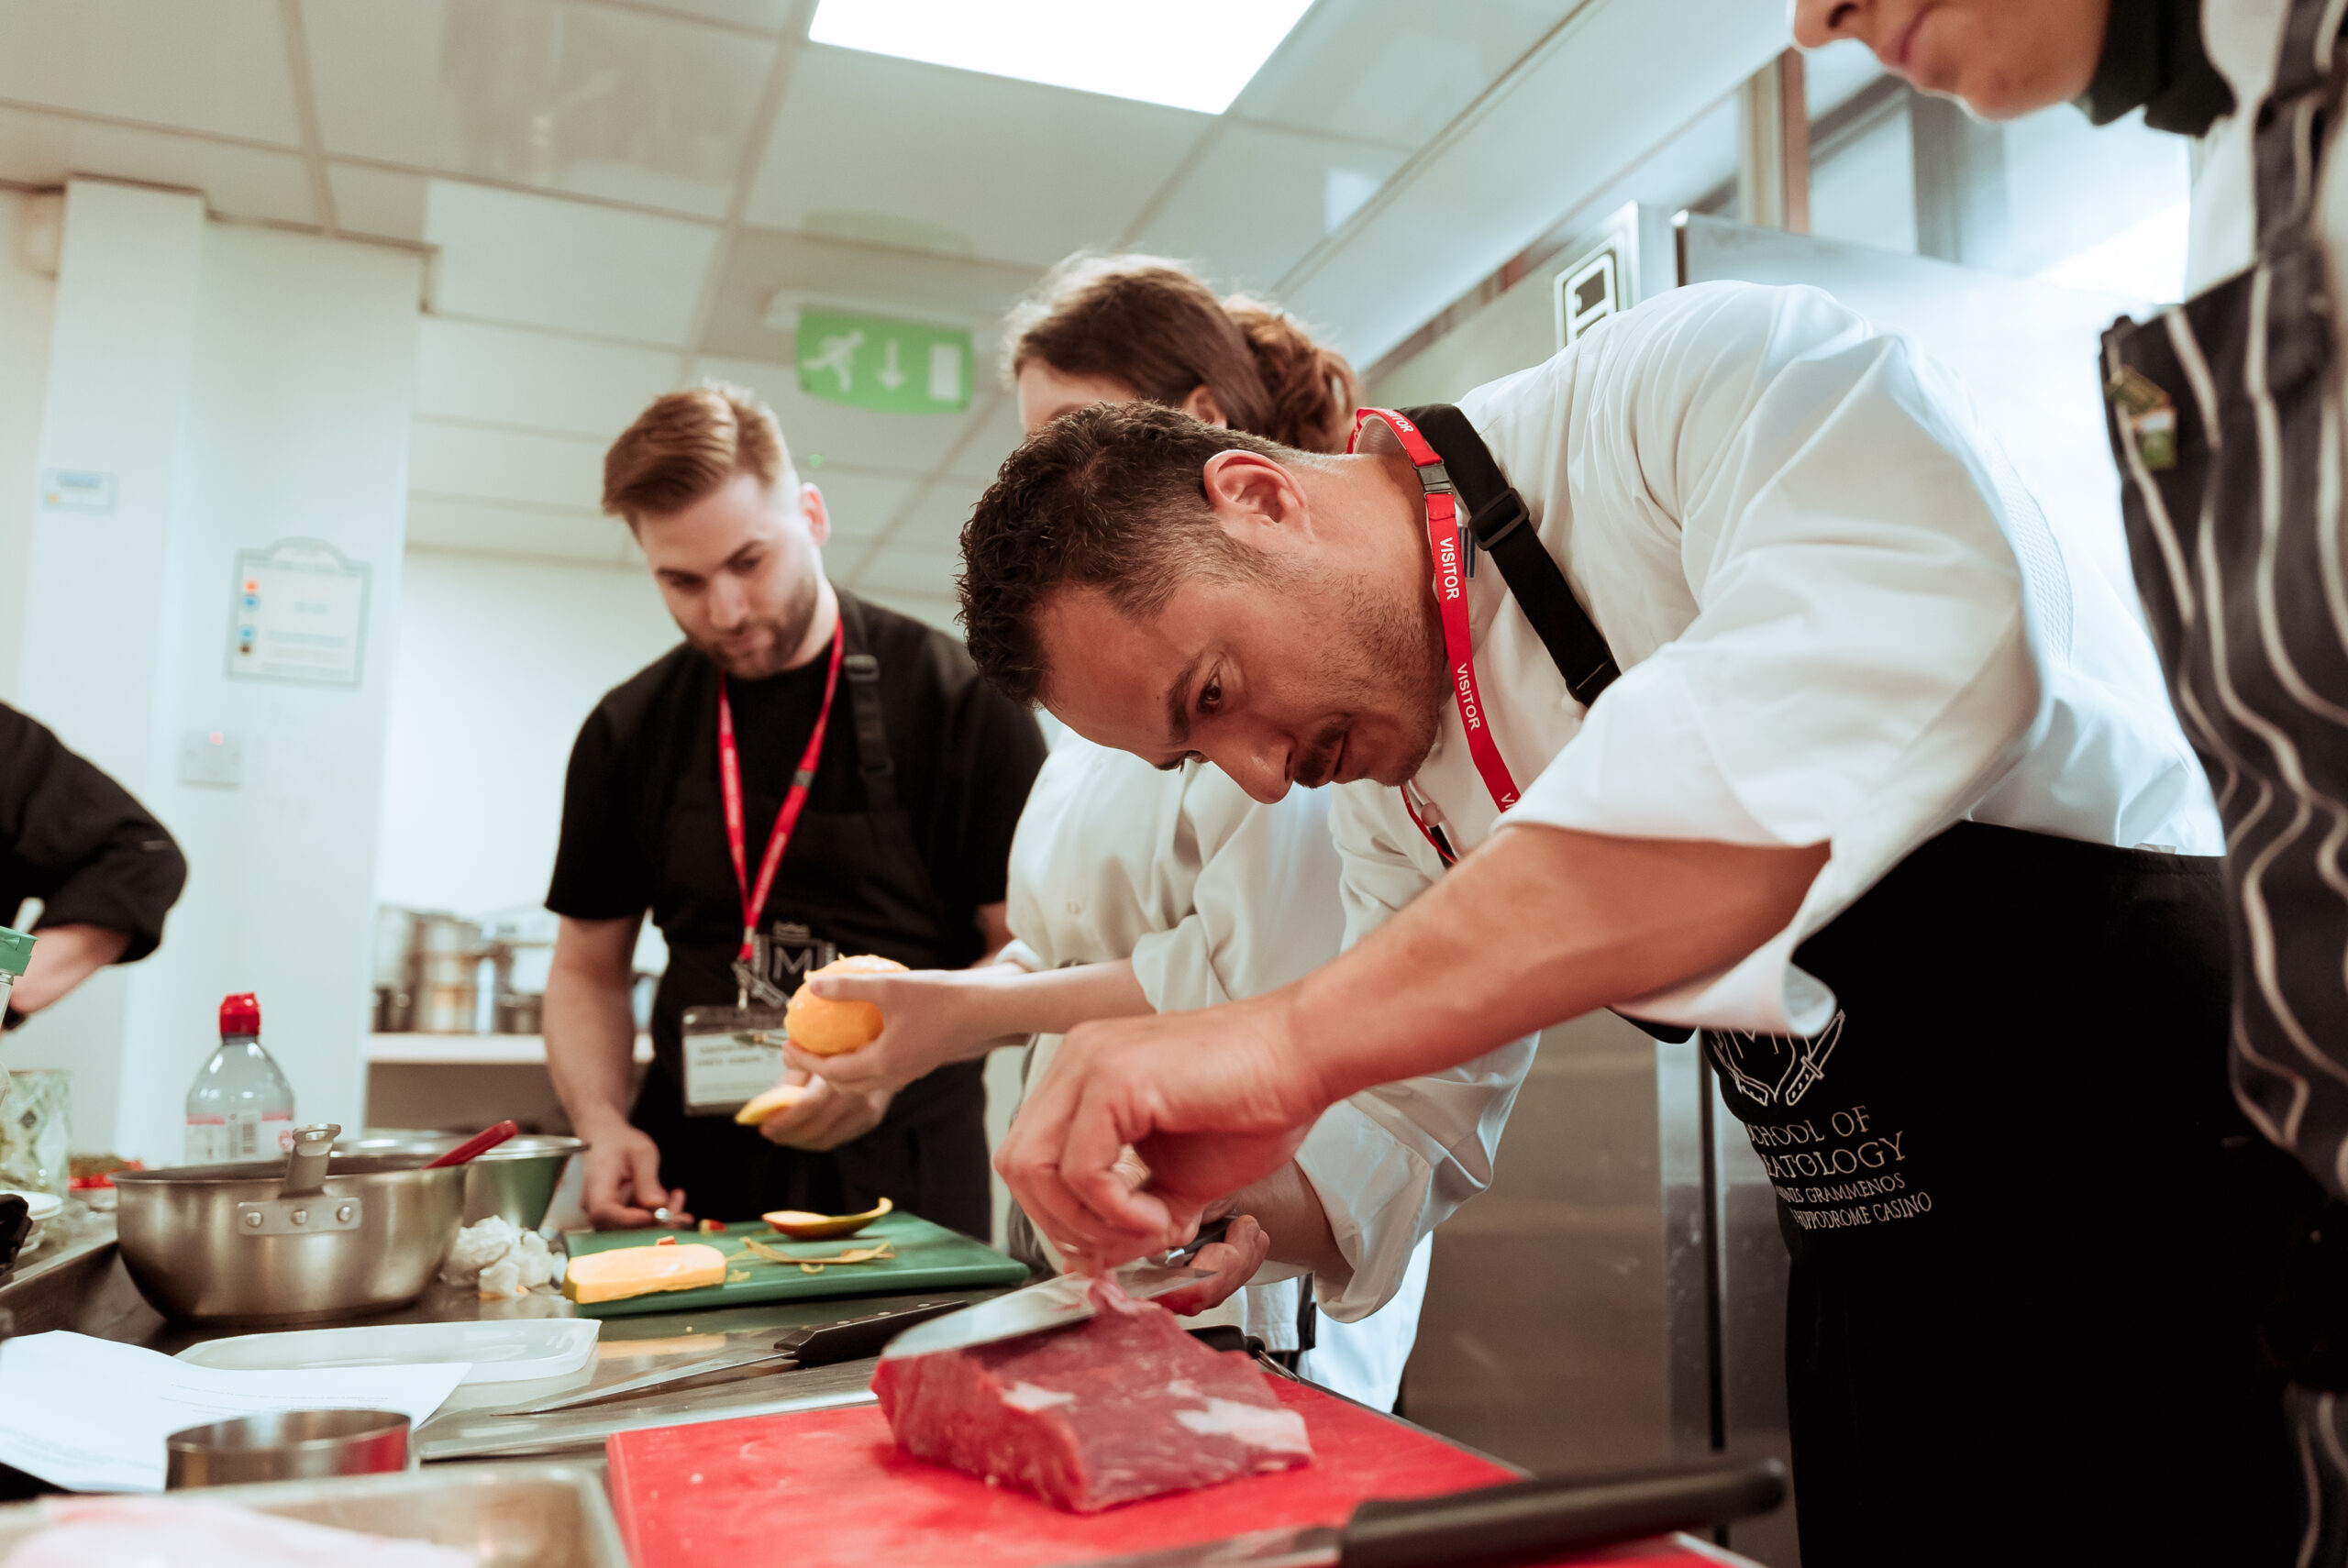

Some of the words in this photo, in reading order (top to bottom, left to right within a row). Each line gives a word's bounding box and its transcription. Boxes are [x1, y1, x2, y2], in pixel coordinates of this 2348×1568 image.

[1439, 536, 1460, 601] VISITOR
[1456, 662, 1480, 732] VISITOR
[1832, 1105, 1870, 1138] OF
[1804, 1172, 1906, 1203] GRAMMENOS
[1872, 1191, 1933, 1222] CASINO
